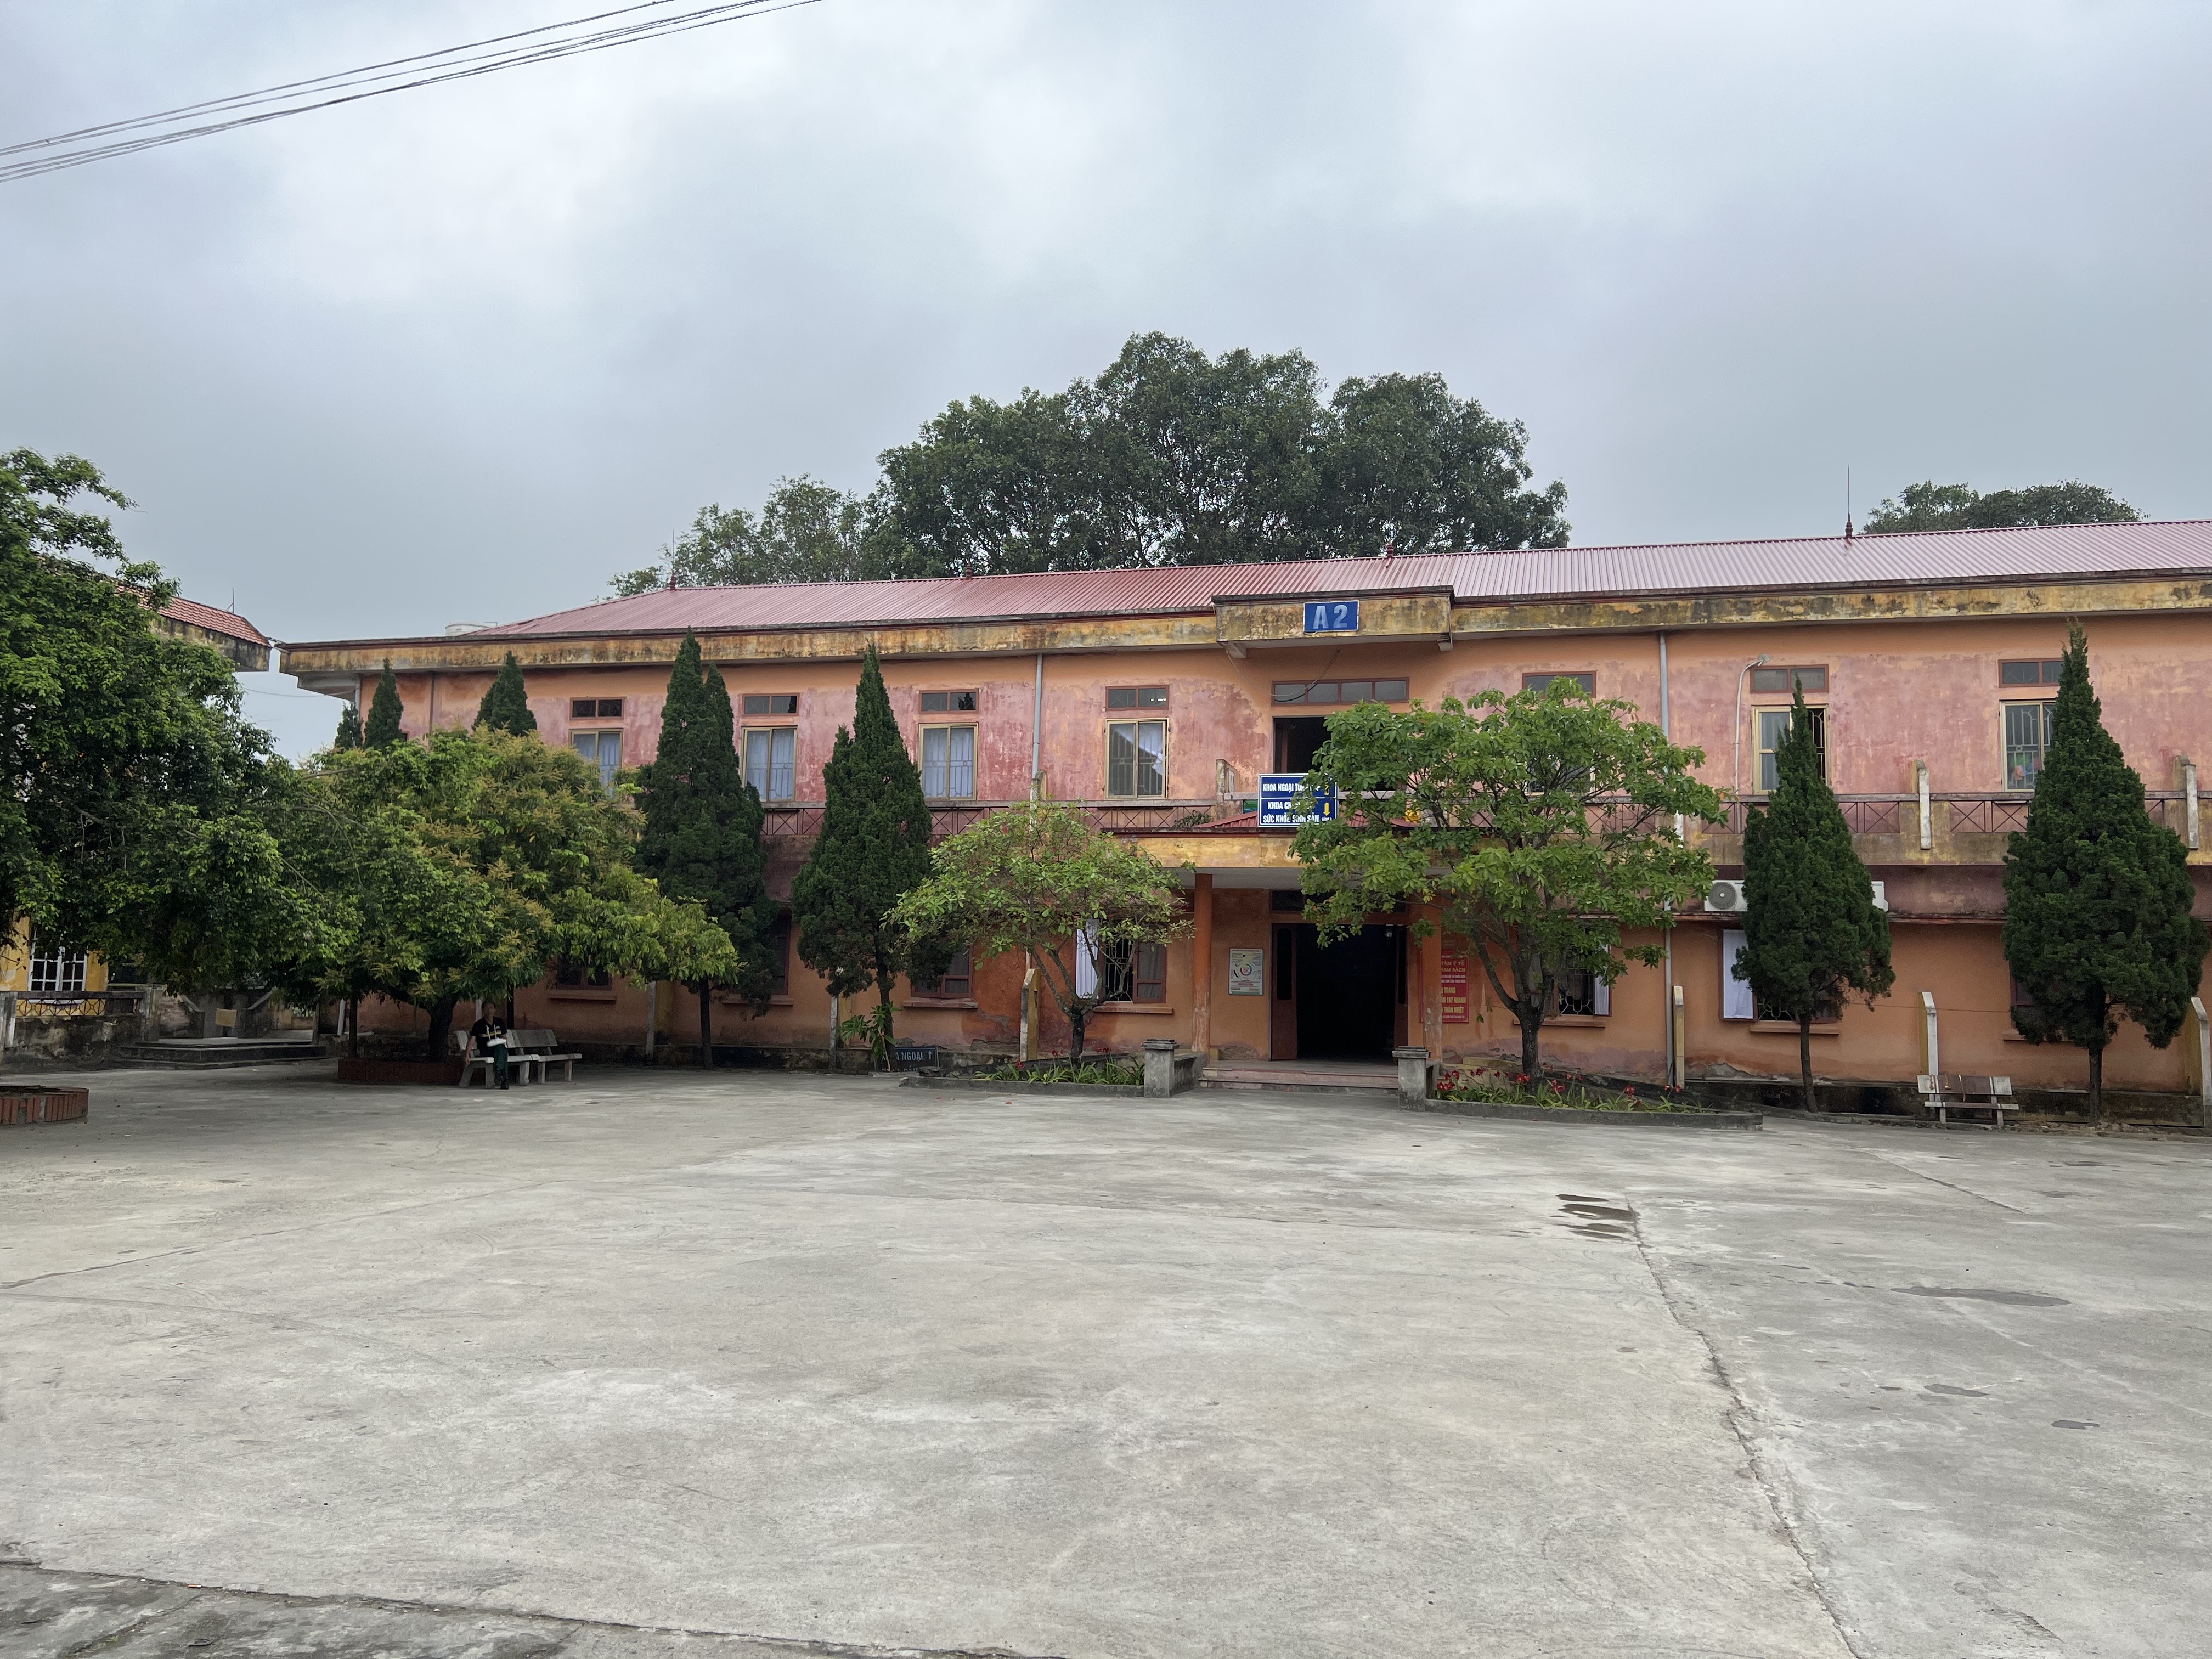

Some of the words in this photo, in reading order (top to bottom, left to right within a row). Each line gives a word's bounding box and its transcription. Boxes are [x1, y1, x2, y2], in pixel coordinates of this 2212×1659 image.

[1312, 605, 1348, 629] A2
[1262, 783, 1276, 792] KHOA
[1277, 783, 1294, 793] NGOẠI
[1268, 802, 1283, 810] KHOA
[1263, 813, 1274, 823] SỨC
[1307, 812, 1319, 823] SẢN
[901, 1052, 923, 1062] NGOẠI
